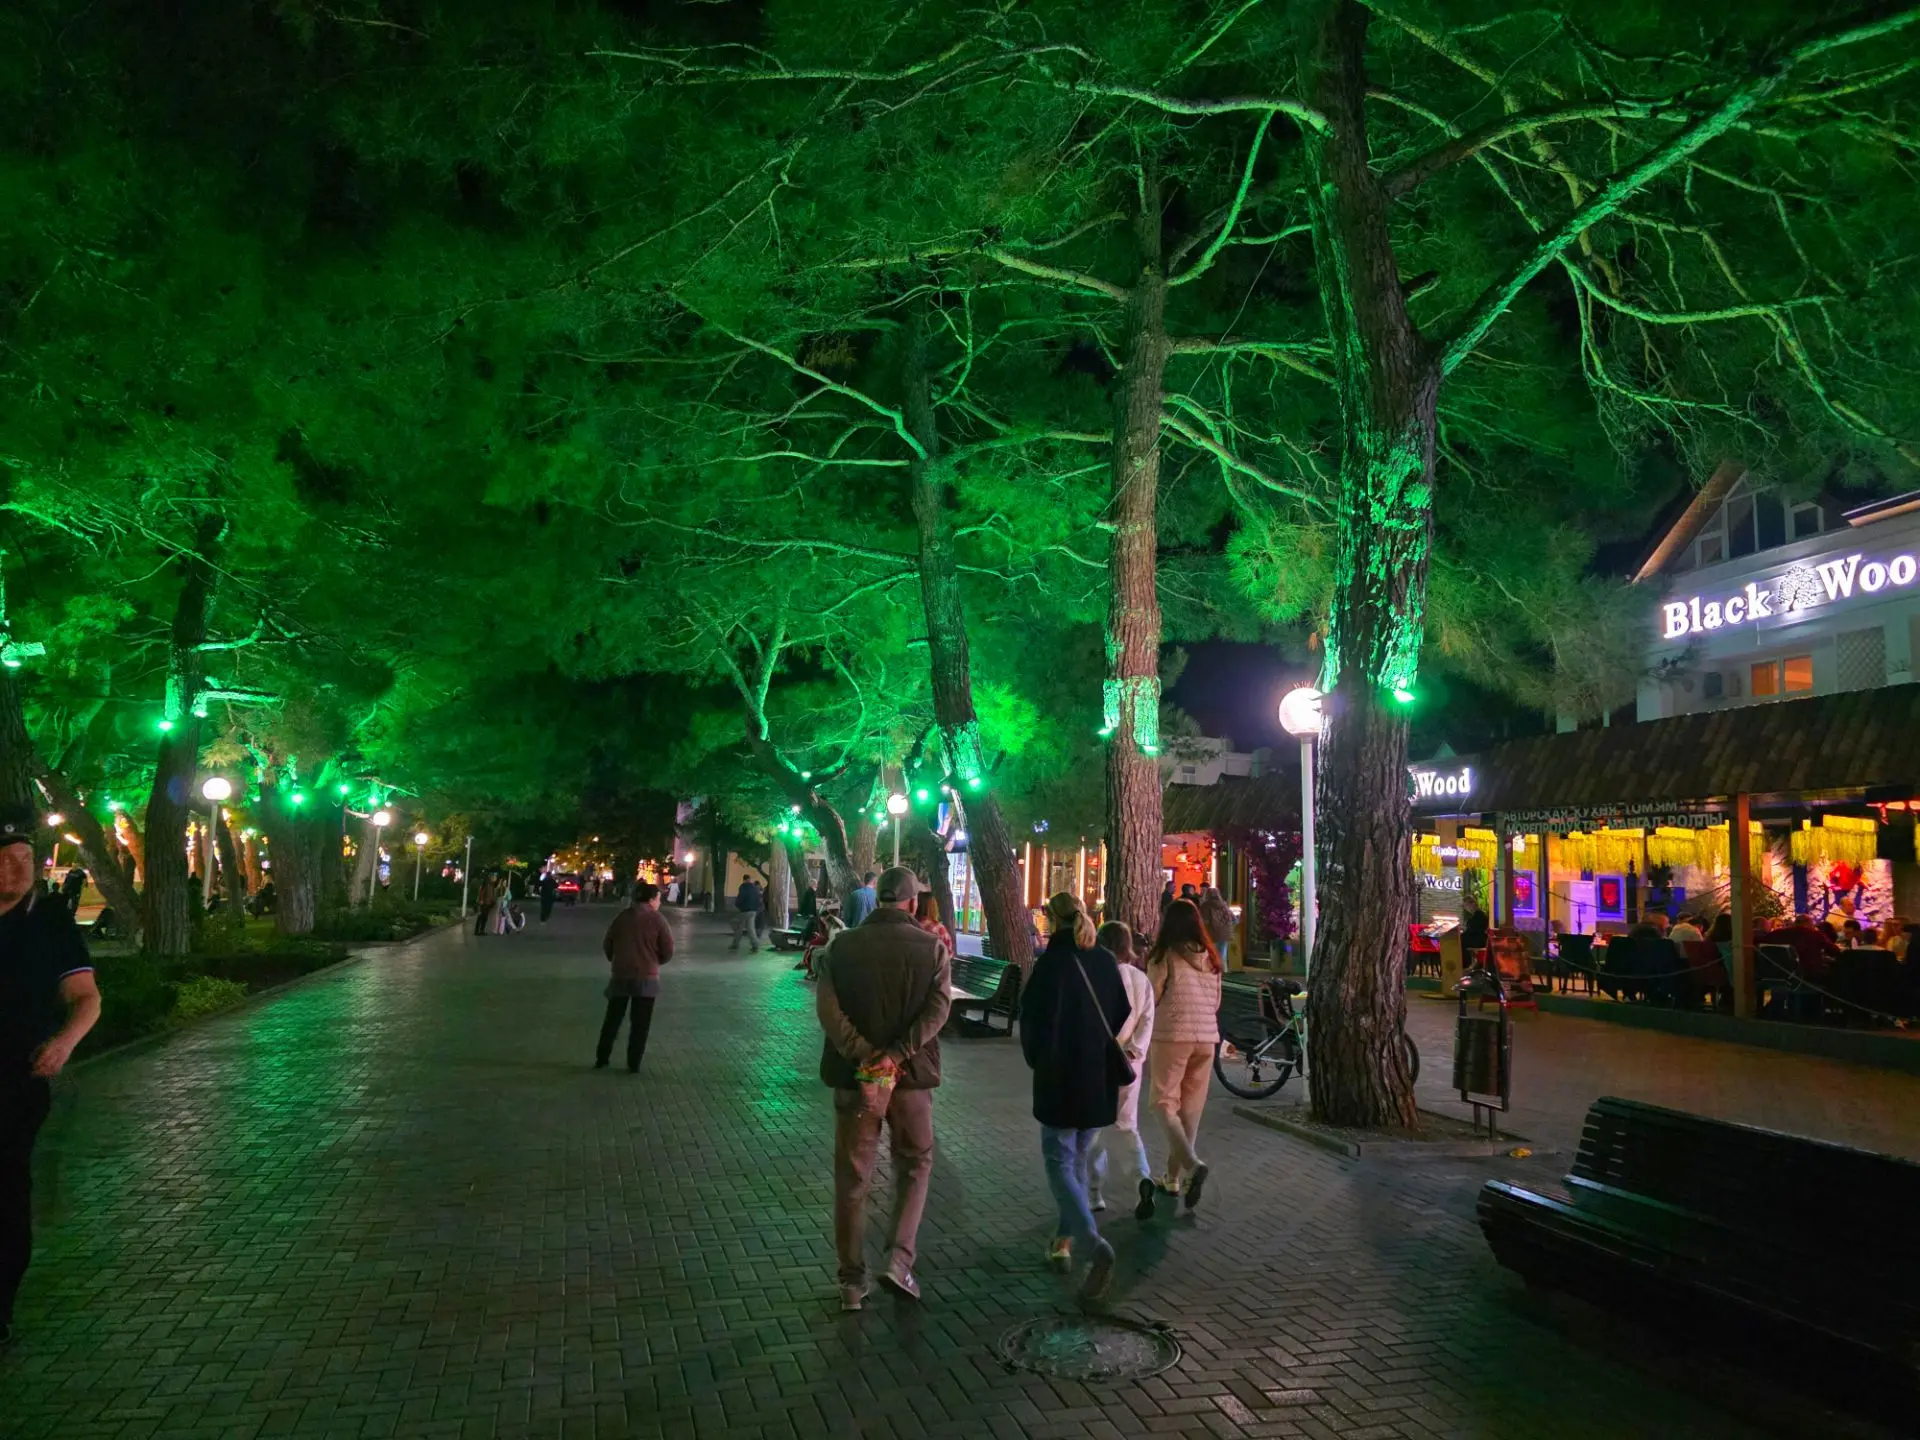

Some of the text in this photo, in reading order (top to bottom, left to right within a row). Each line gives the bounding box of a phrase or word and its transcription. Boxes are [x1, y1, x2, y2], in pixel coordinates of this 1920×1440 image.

[1663, 554, 1920, 639] Black Woo
[1417, 767, 1471, 796] Wood
[1503, 808, 1569, 822] АВТОРСКАЯ
[1425, 873, 1463, 889] Wood
